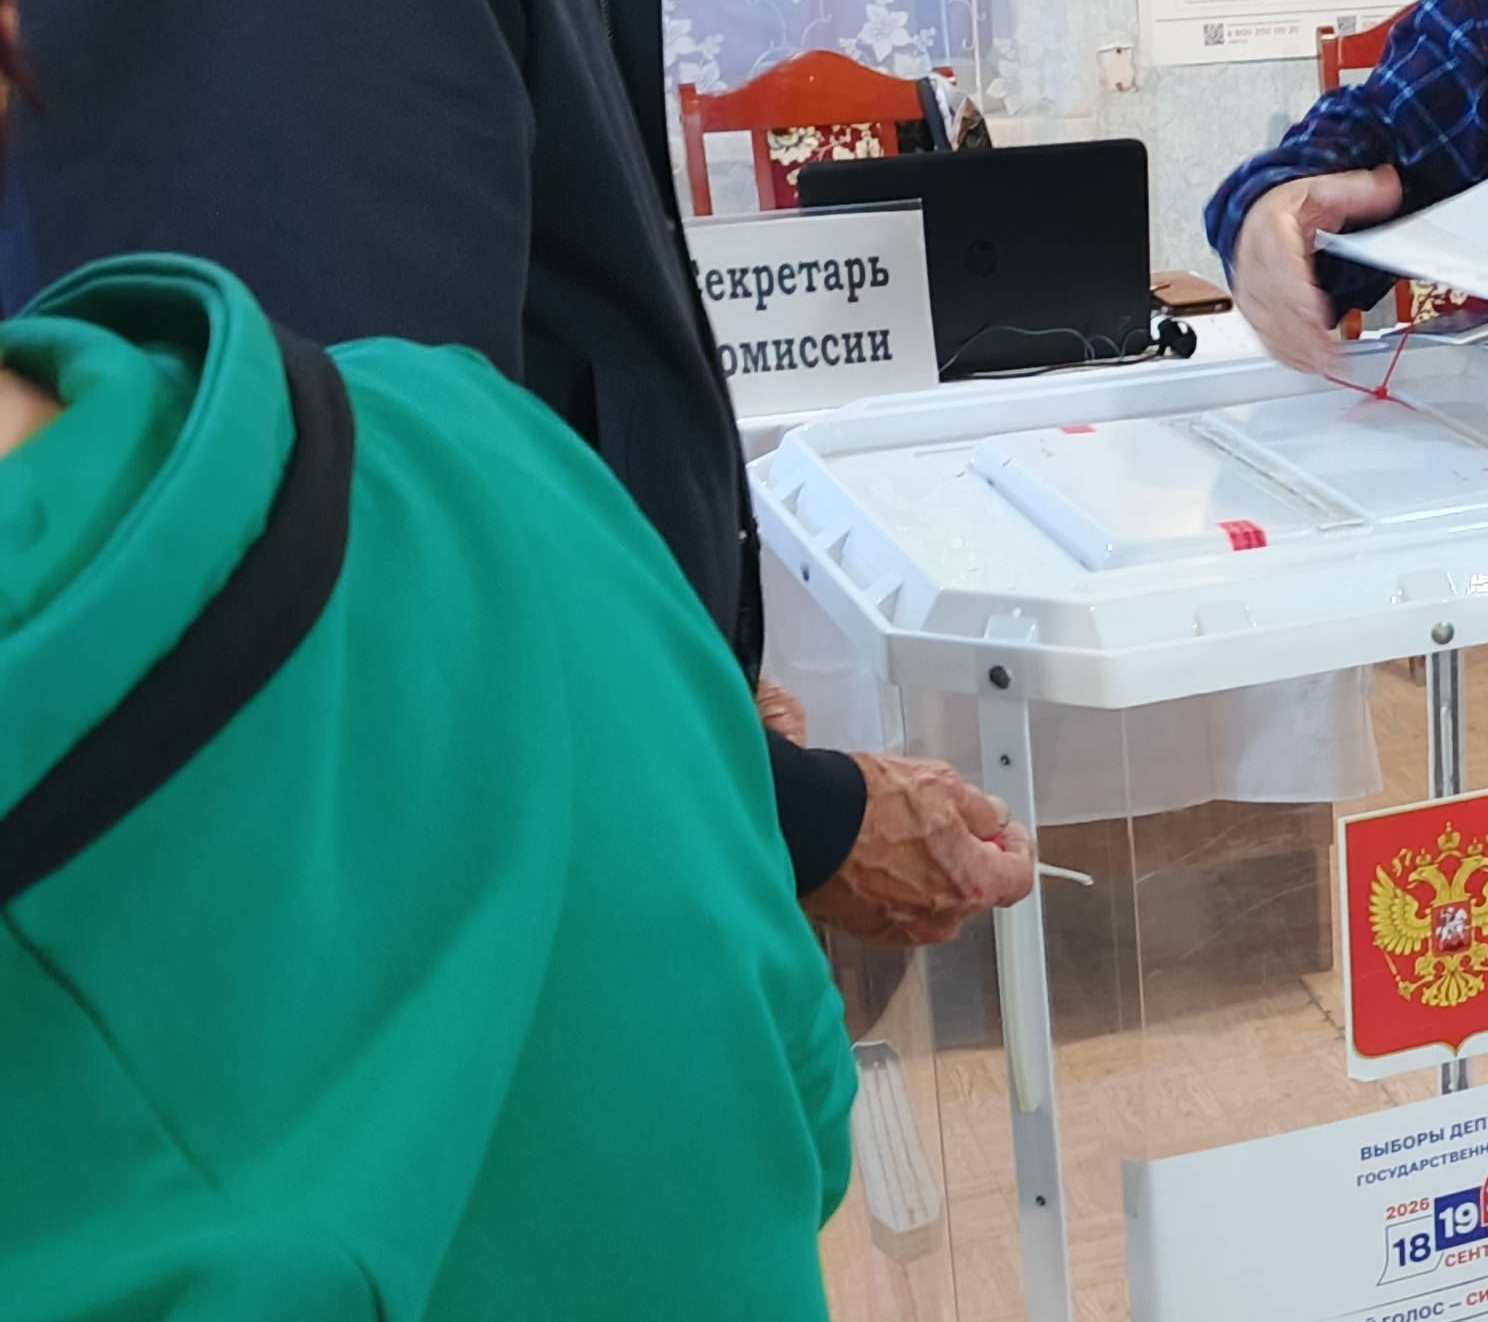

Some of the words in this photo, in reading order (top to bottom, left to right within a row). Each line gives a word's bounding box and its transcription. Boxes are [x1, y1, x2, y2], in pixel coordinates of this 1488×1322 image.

[717, 328, 893, 378] омиссии
[1360, 1126, 1445, 1161] ВЫБОРЫ
[1385, 1197, 1430, 1221] 2026
[1392, 1232, 1432, 1268] 18
[1438, 1201, 1479, 1239] 19
